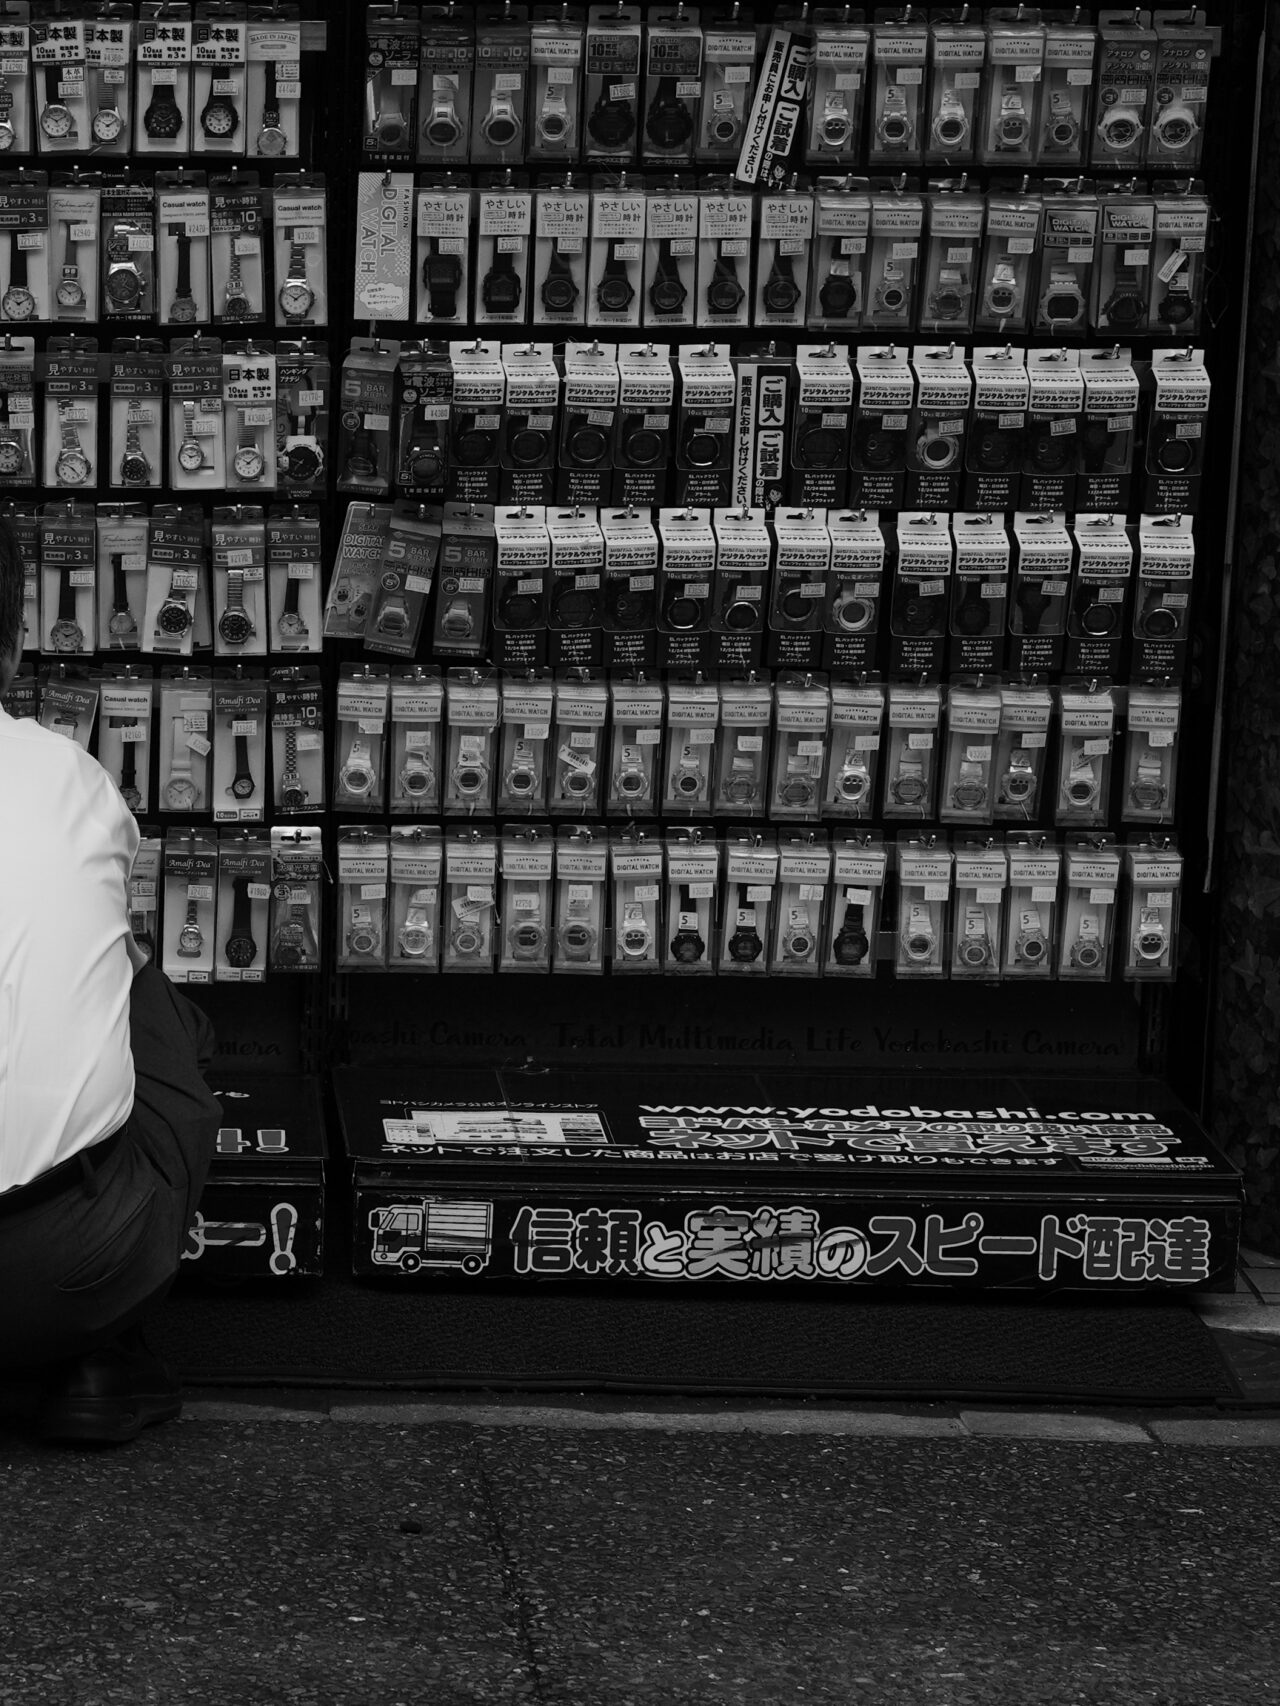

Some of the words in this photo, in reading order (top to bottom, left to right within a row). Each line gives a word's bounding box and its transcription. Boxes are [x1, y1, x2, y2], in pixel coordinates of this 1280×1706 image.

[144, 28, 185, 41] 日本製
[198, 28, 239, 41] 日本製
[423, 201, 463, 211] やさしい
[542, 201, 583, 211] やさしい
[706, 202, 746, 212] やさしい
[768, 203, 807, 213] やさしい
[381, 188, 397, 256] DIGITAL
[446, 213, 463, 221] 時計
[566, 213, 583, 221] 時計
[730, 214, 747, 222] 時計
[790, 215, 808, 223] 時計
[360, 208, 380, 274] WATCH
[230, 370, 270, 383] 日本製
[345, 380, 362, 396] 5
[50, 690, 74, 702] Amalfi
[220, 695, 243, 706] Amalfi
[170, 859, 194, 869] Amalfi
[550, 1023, 624, 1048] Total
[807, 1026, 863, 1051] Life
[1022, 1029, 1120, 1055] Camera
[638, 1105, 1156, 1121] www.yodobashi.com
[646, 1128, 1183, 1156] ネットで買えます
[510, 1205, 1211, 1282] 信頼と実績のスピード配達
